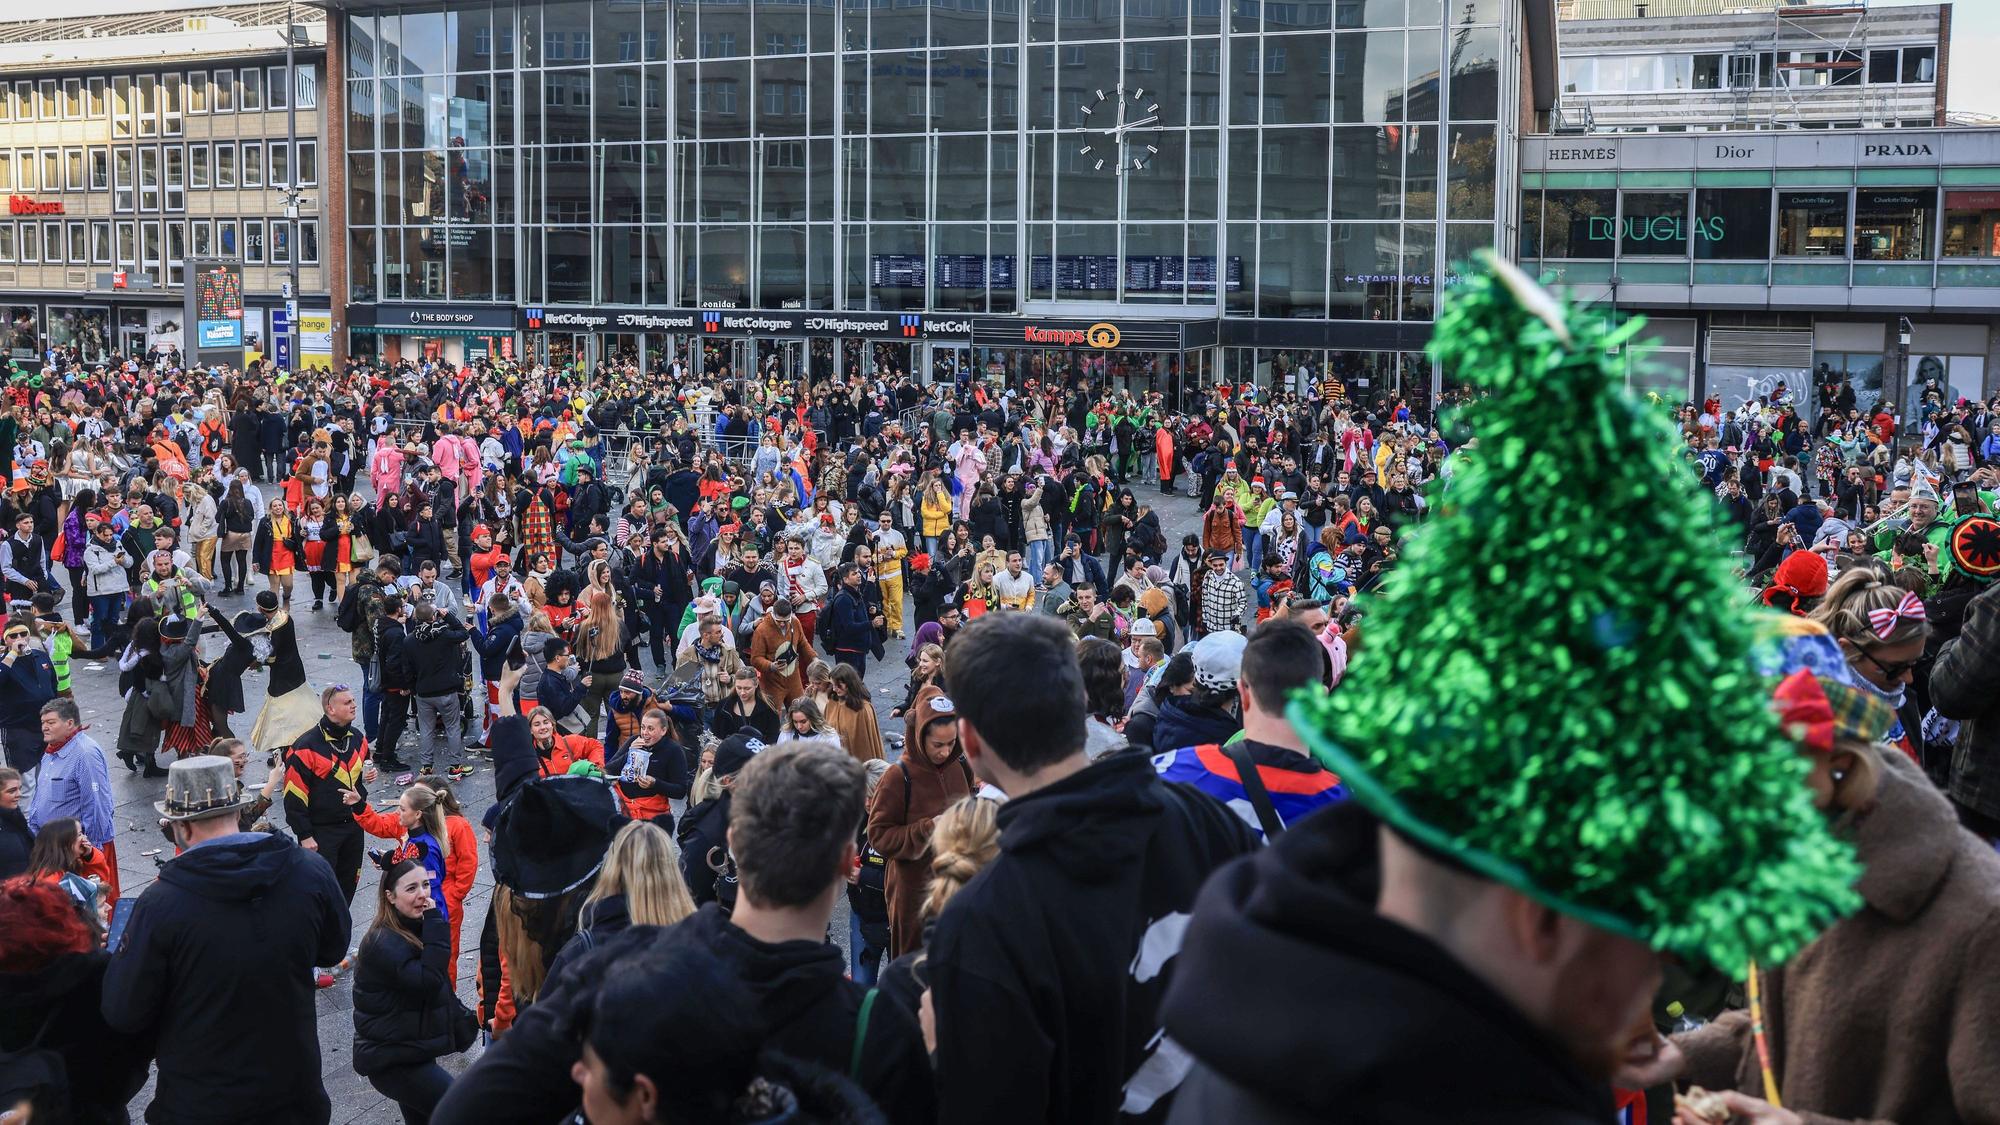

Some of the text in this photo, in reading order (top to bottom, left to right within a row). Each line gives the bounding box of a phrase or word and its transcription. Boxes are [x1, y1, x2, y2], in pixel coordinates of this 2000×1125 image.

[1715, 145, 1754, 159] Dior
[1865, 144, 1932, 156] PRADA
[1589, 216, 1724, 240] DOUGLAS
[421, 313, 473, 322] THE BODY SHOP
[545, 313, 694, 329] NetCologne Highspeed
[723, 317, 888, 332] NetCologne Highspeed
[1025, 325, 1085, 346] Kamps
